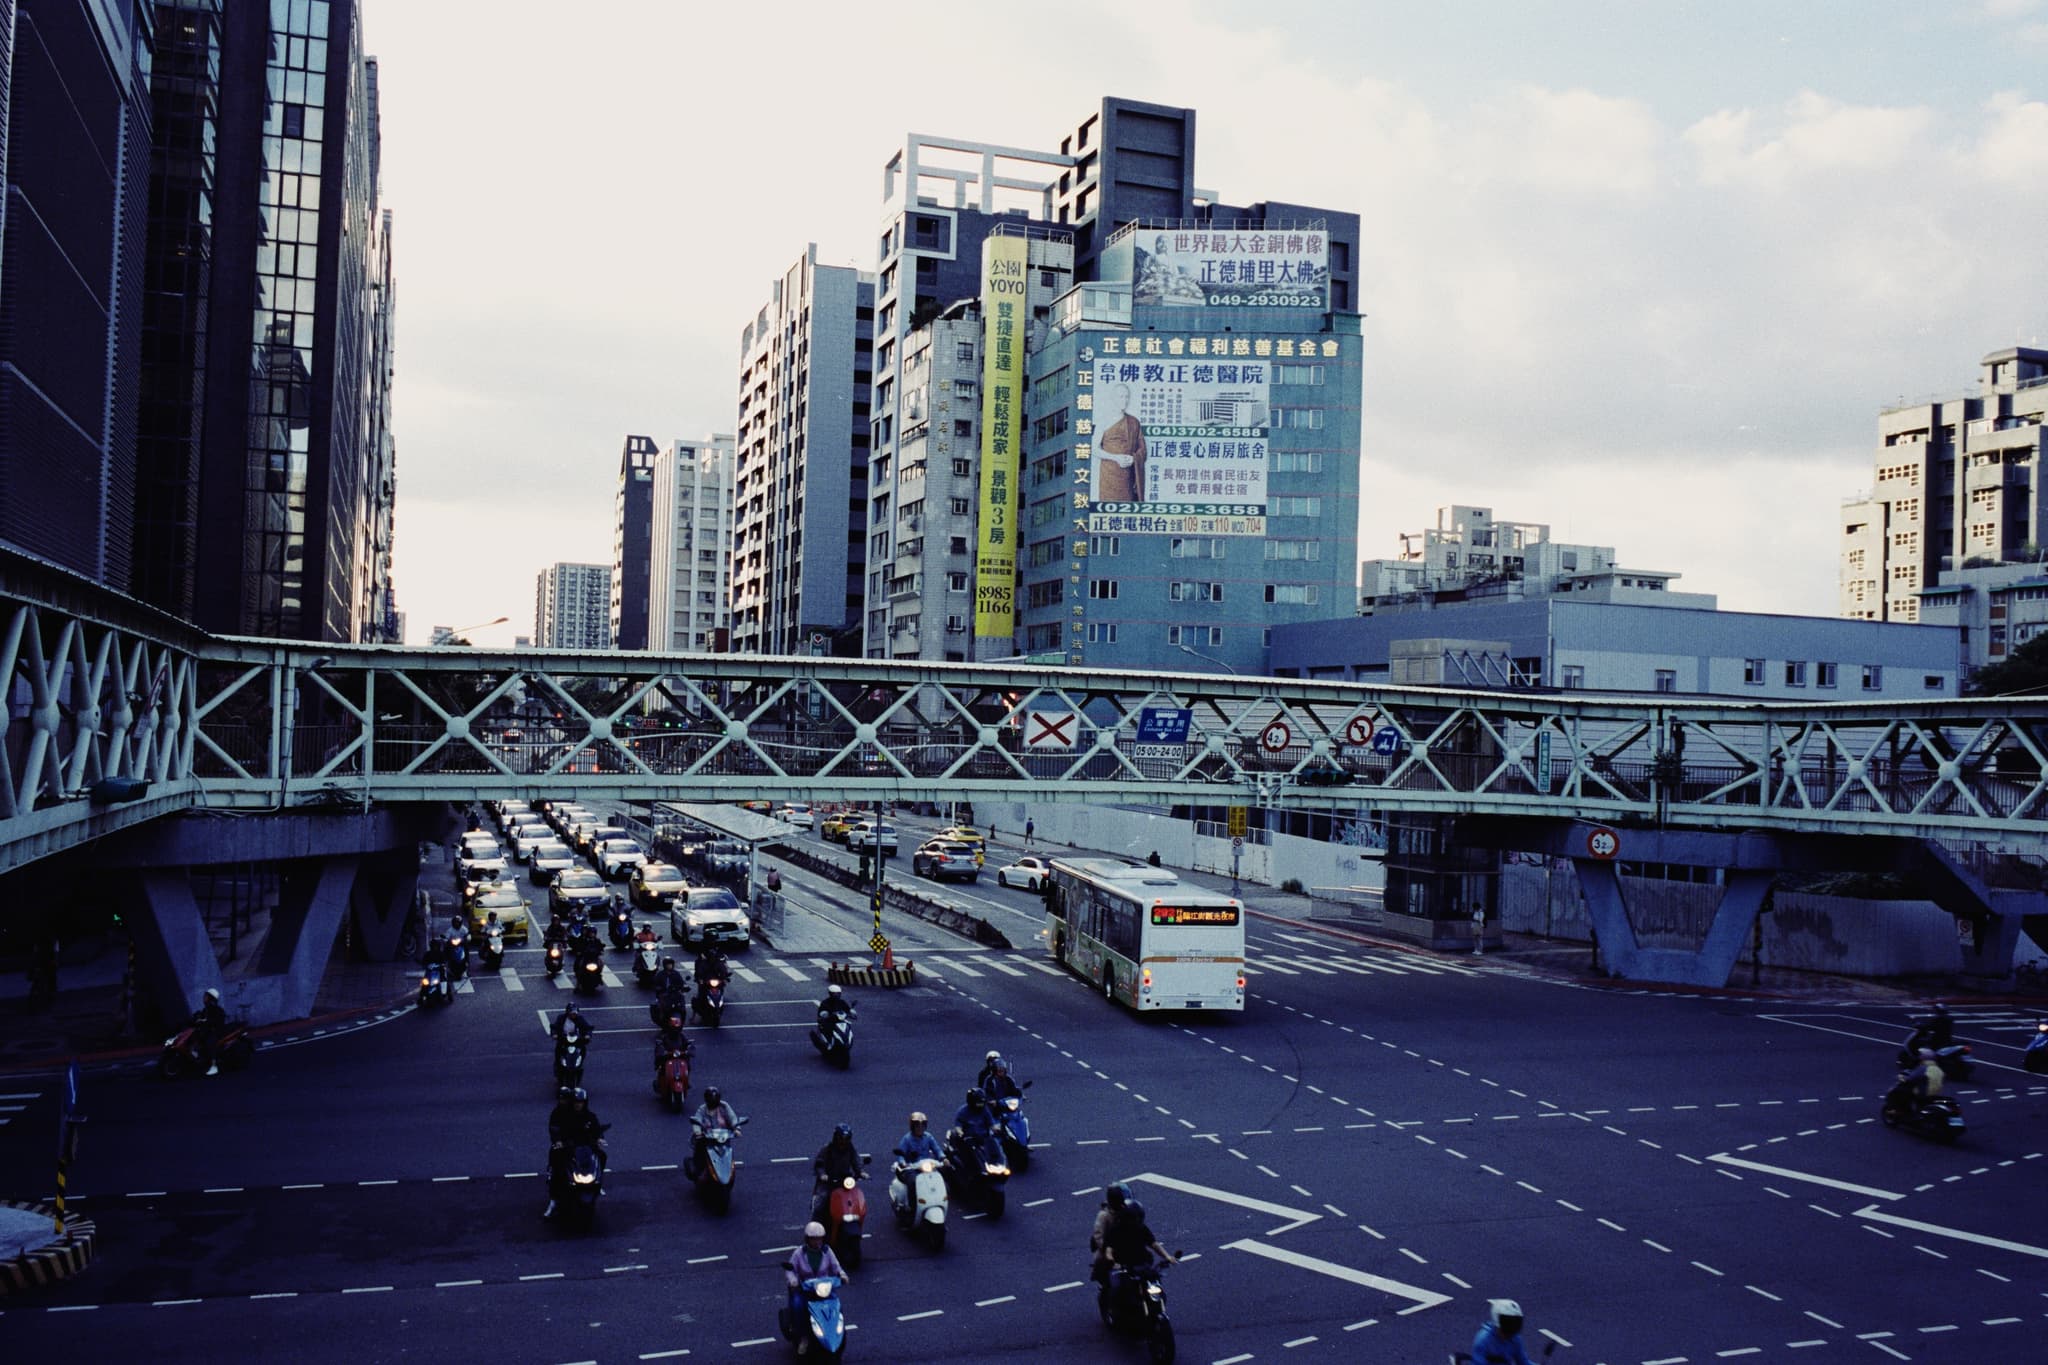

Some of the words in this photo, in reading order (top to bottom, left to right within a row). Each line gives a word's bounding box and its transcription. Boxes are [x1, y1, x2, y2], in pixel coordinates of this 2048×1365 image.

[1174, 233, 1322, 253] 世界最大金銅佛像
[992, 259, 1021, 277] 公園
[1200, 259, 1315, 284] 正德埔里大佛
[990, 279, 1025, 295] YOYO
[1210, 295, 1321, 307] 049-2930923
[1103, 337, 1339, 357] 正德社會福利慈善基金會
[1146, 427, 1261, 438] (04)3702-6588
[1150, 441, 1265, 460] 正德愛心廚房旅舍
[1163, 469, 1261, 482] 長期提供貧民街友
[1175, 482, 1248, 496] 免費用餐住宿
[1096, 503, 1260, 515] (02)2593-3658
[979, 586, 1011, 600] 8985
[980, 600, 1010, 614] 1166
